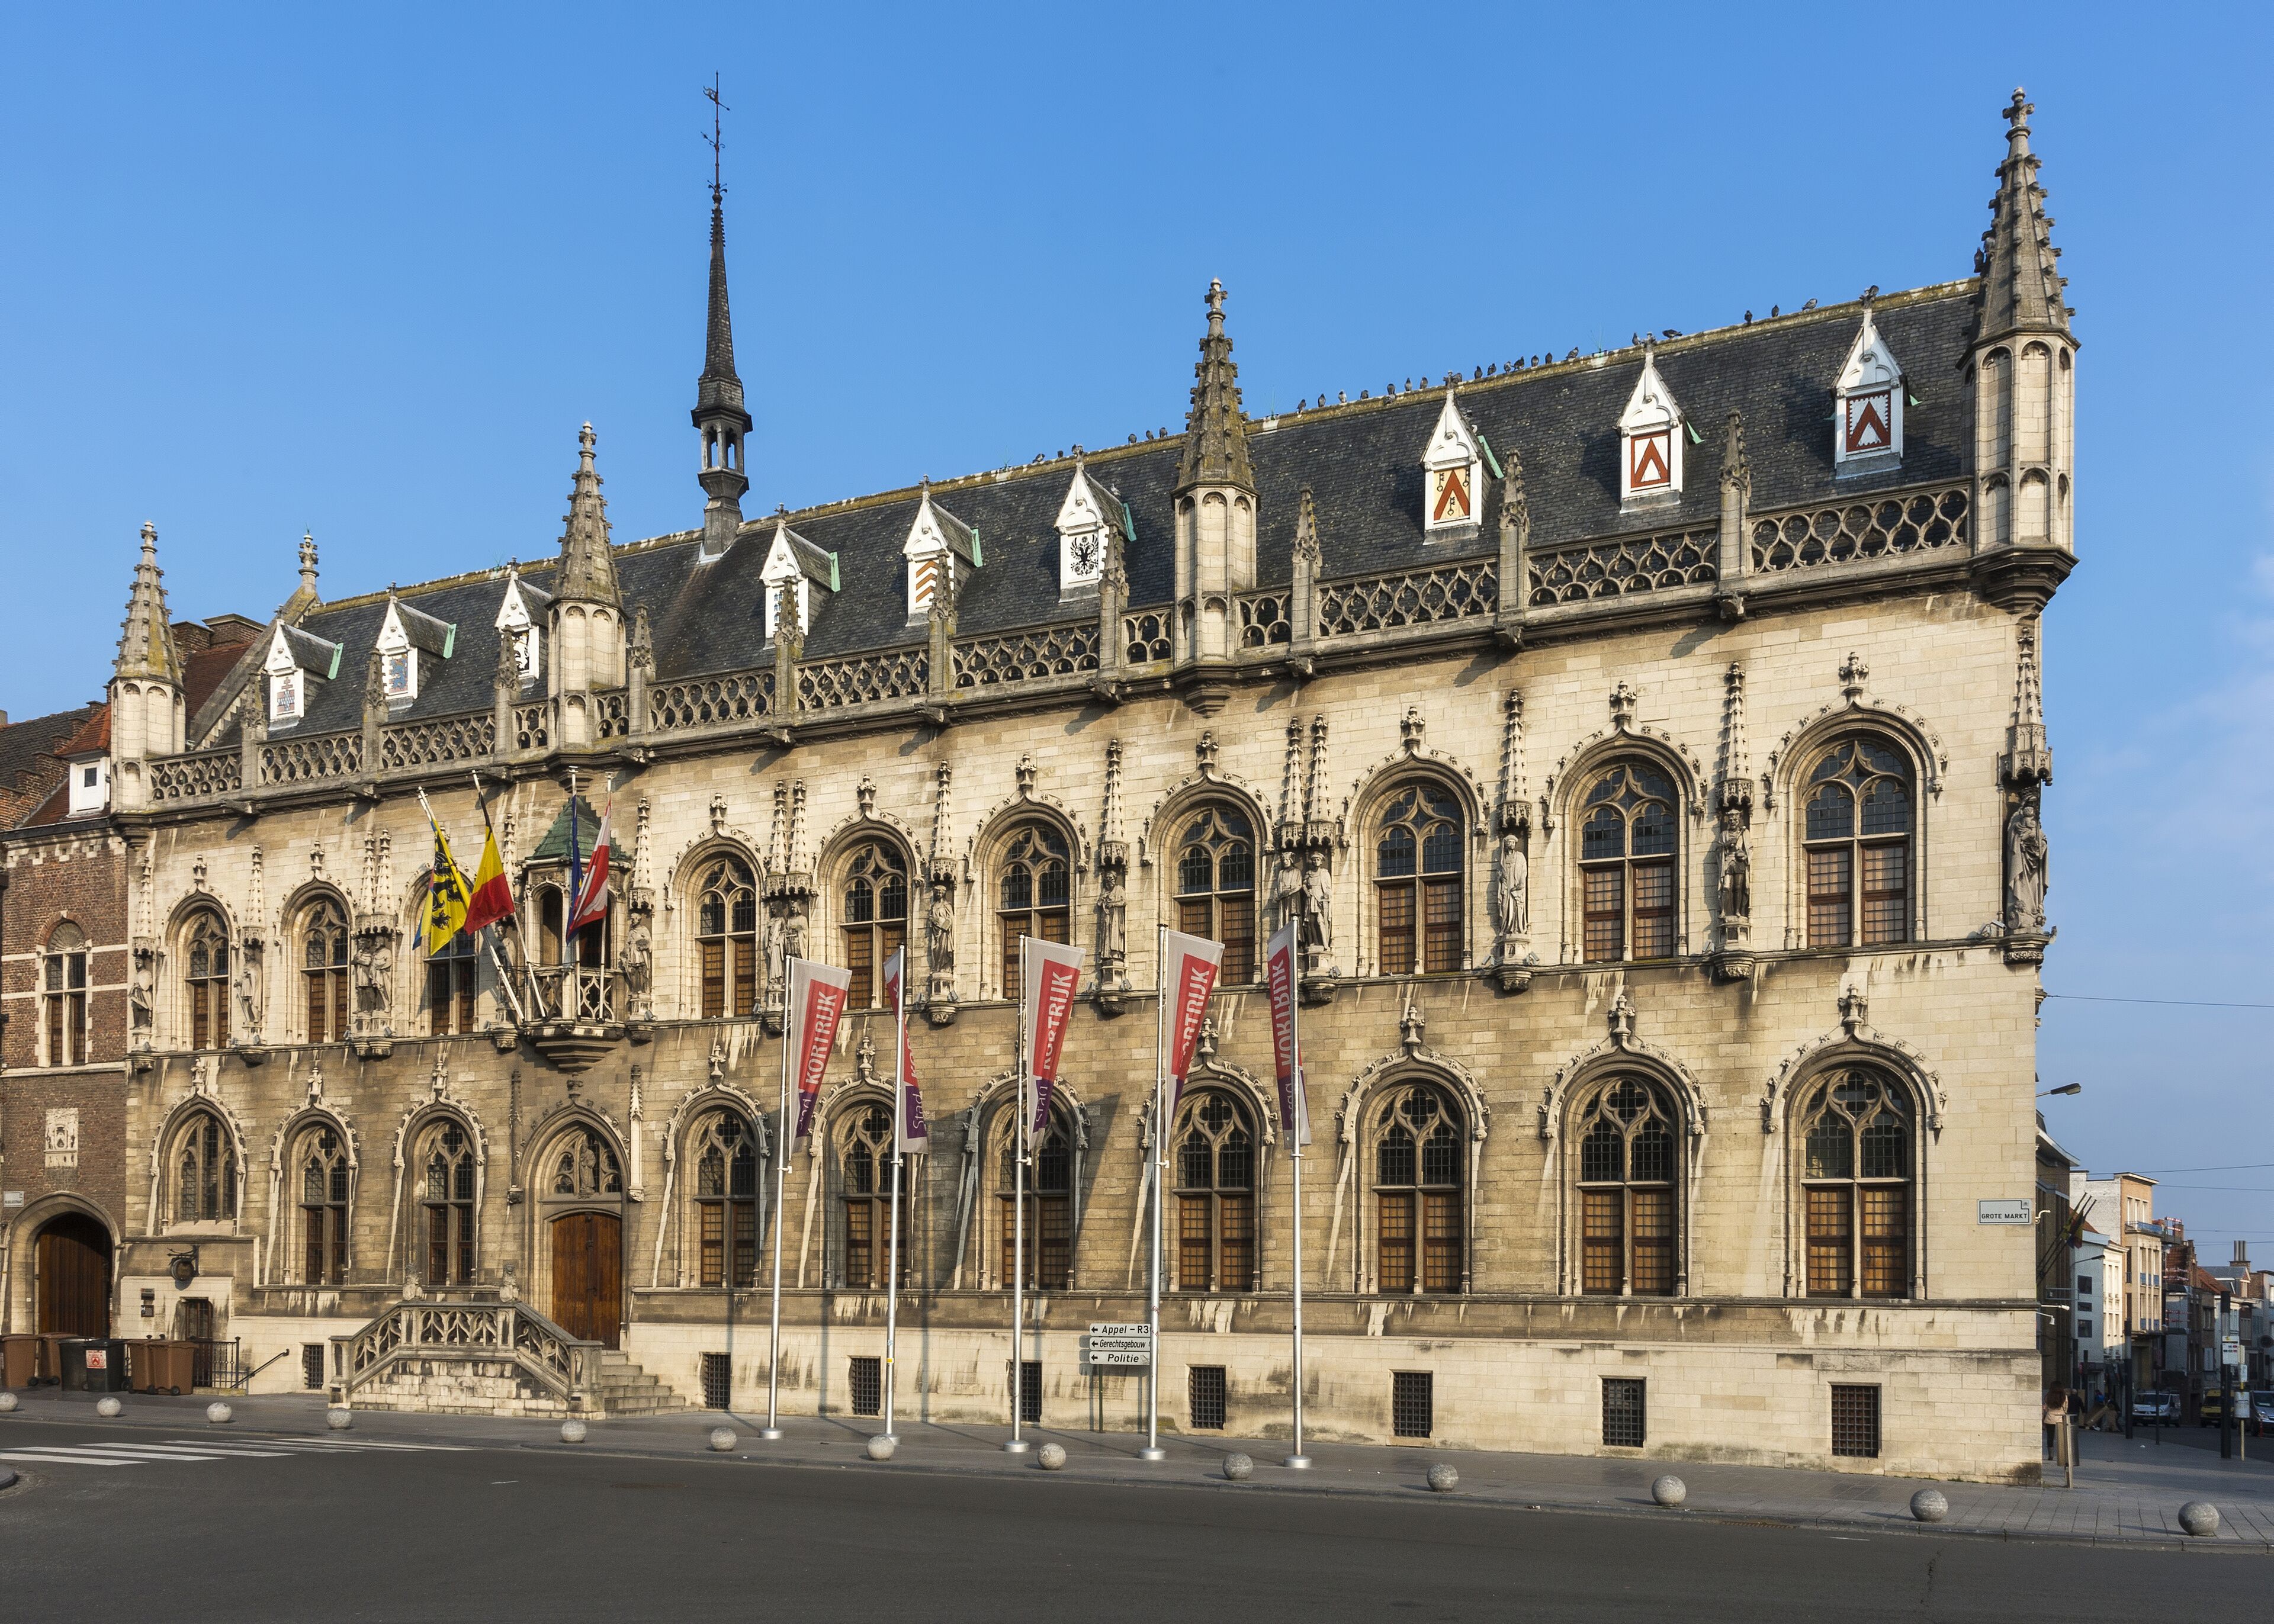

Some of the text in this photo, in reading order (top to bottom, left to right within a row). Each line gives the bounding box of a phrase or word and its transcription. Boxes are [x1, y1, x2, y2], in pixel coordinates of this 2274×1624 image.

[1180, 966, 1210, 1067] RTRIJK
[805, 991, 837, 1084] KORTRIJK
[1101, 1325, 1127, 1335] Appel
[1137, 1326, 1149, 1334] R3
[1100, 1339, 1146, 1349] Gerechtsgebouw
[1107, 1354, 1139, 1362] Politie
